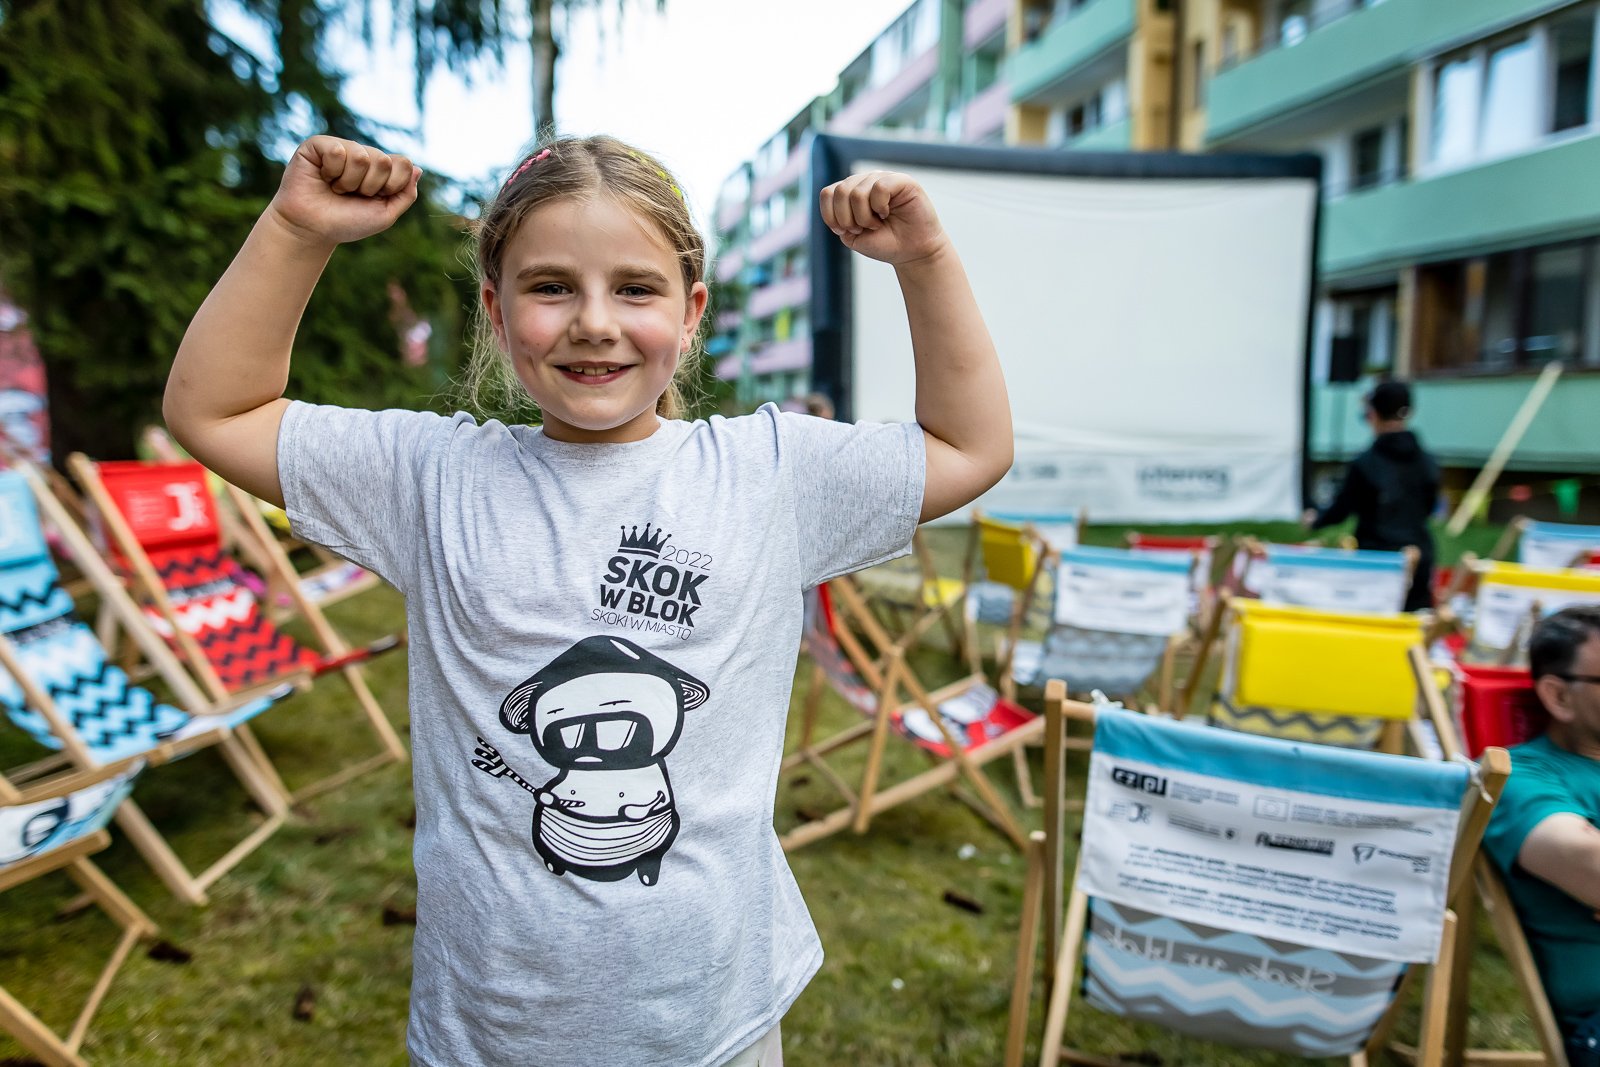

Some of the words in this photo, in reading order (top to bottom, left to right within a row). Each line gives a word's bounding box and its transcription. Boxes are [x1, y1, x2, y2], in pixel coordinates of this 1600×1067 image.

[662, 544, 713, 571] 2022
[603, 555, 709, 606] SKOK
[590, 608, 629, 628] SKOKI
[630, 616, 646, 631] W
[645, 622, 692, 641] MIASTO
[600, 584, 626, 610] W
[626, 591, 702, 628] BLOK
